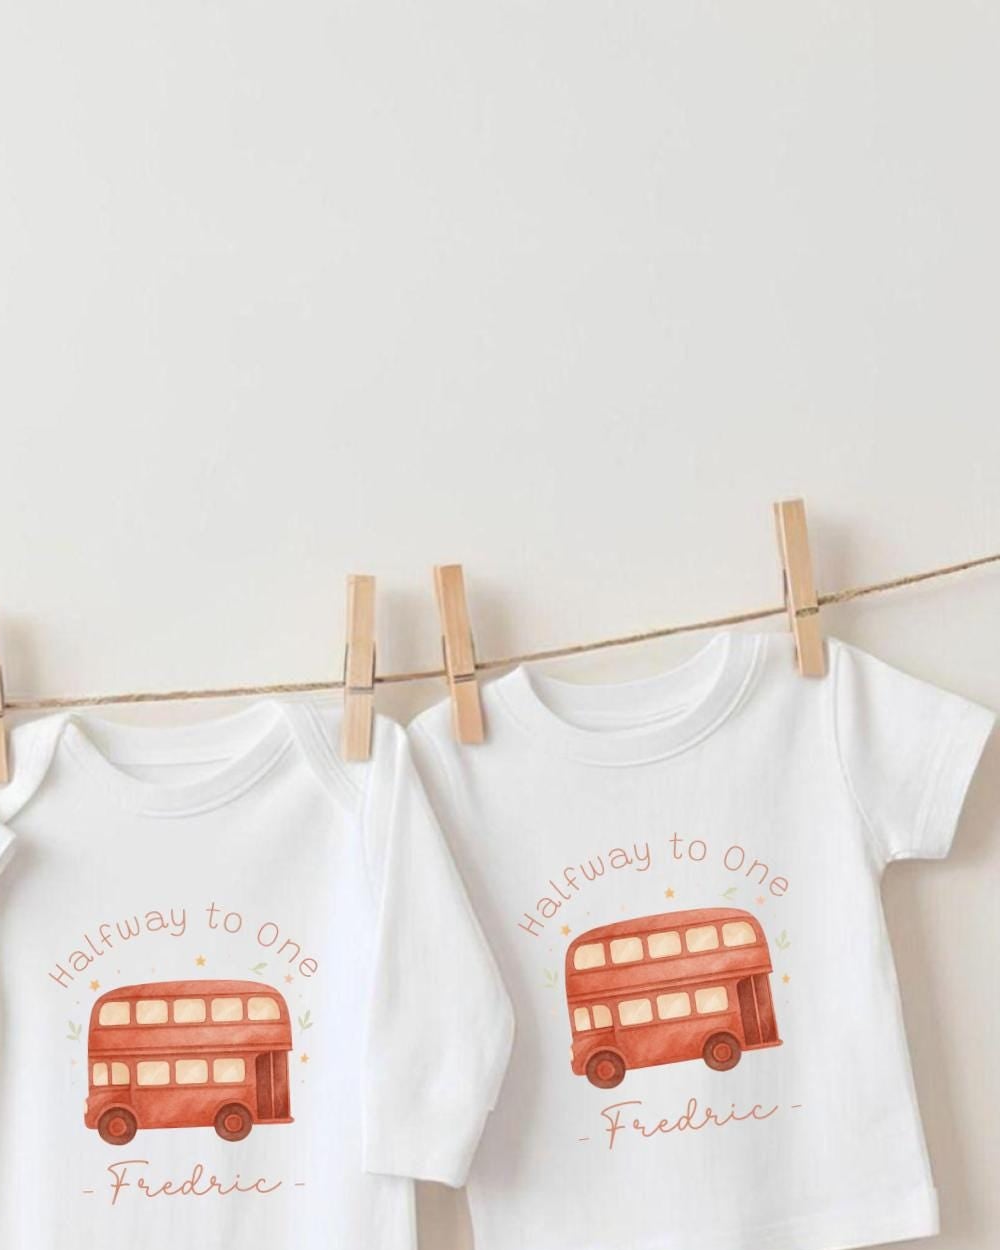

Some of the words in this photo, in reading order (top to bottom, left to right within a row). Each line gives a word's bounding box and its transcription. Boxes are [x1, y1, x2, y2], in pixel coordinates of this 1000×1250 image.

[516, 841, 652, 938] Halfway
[668, 831, 708, 862] to
[722, 845, 790, 898] One
[48, 907, 187, 989] Halfway
[205, 901, 243, 934] to
[256, 921, 319, 979] One
[599, 1097, 779, 1150] Fredric
[106, 1159, 282, 1206] Fredric
